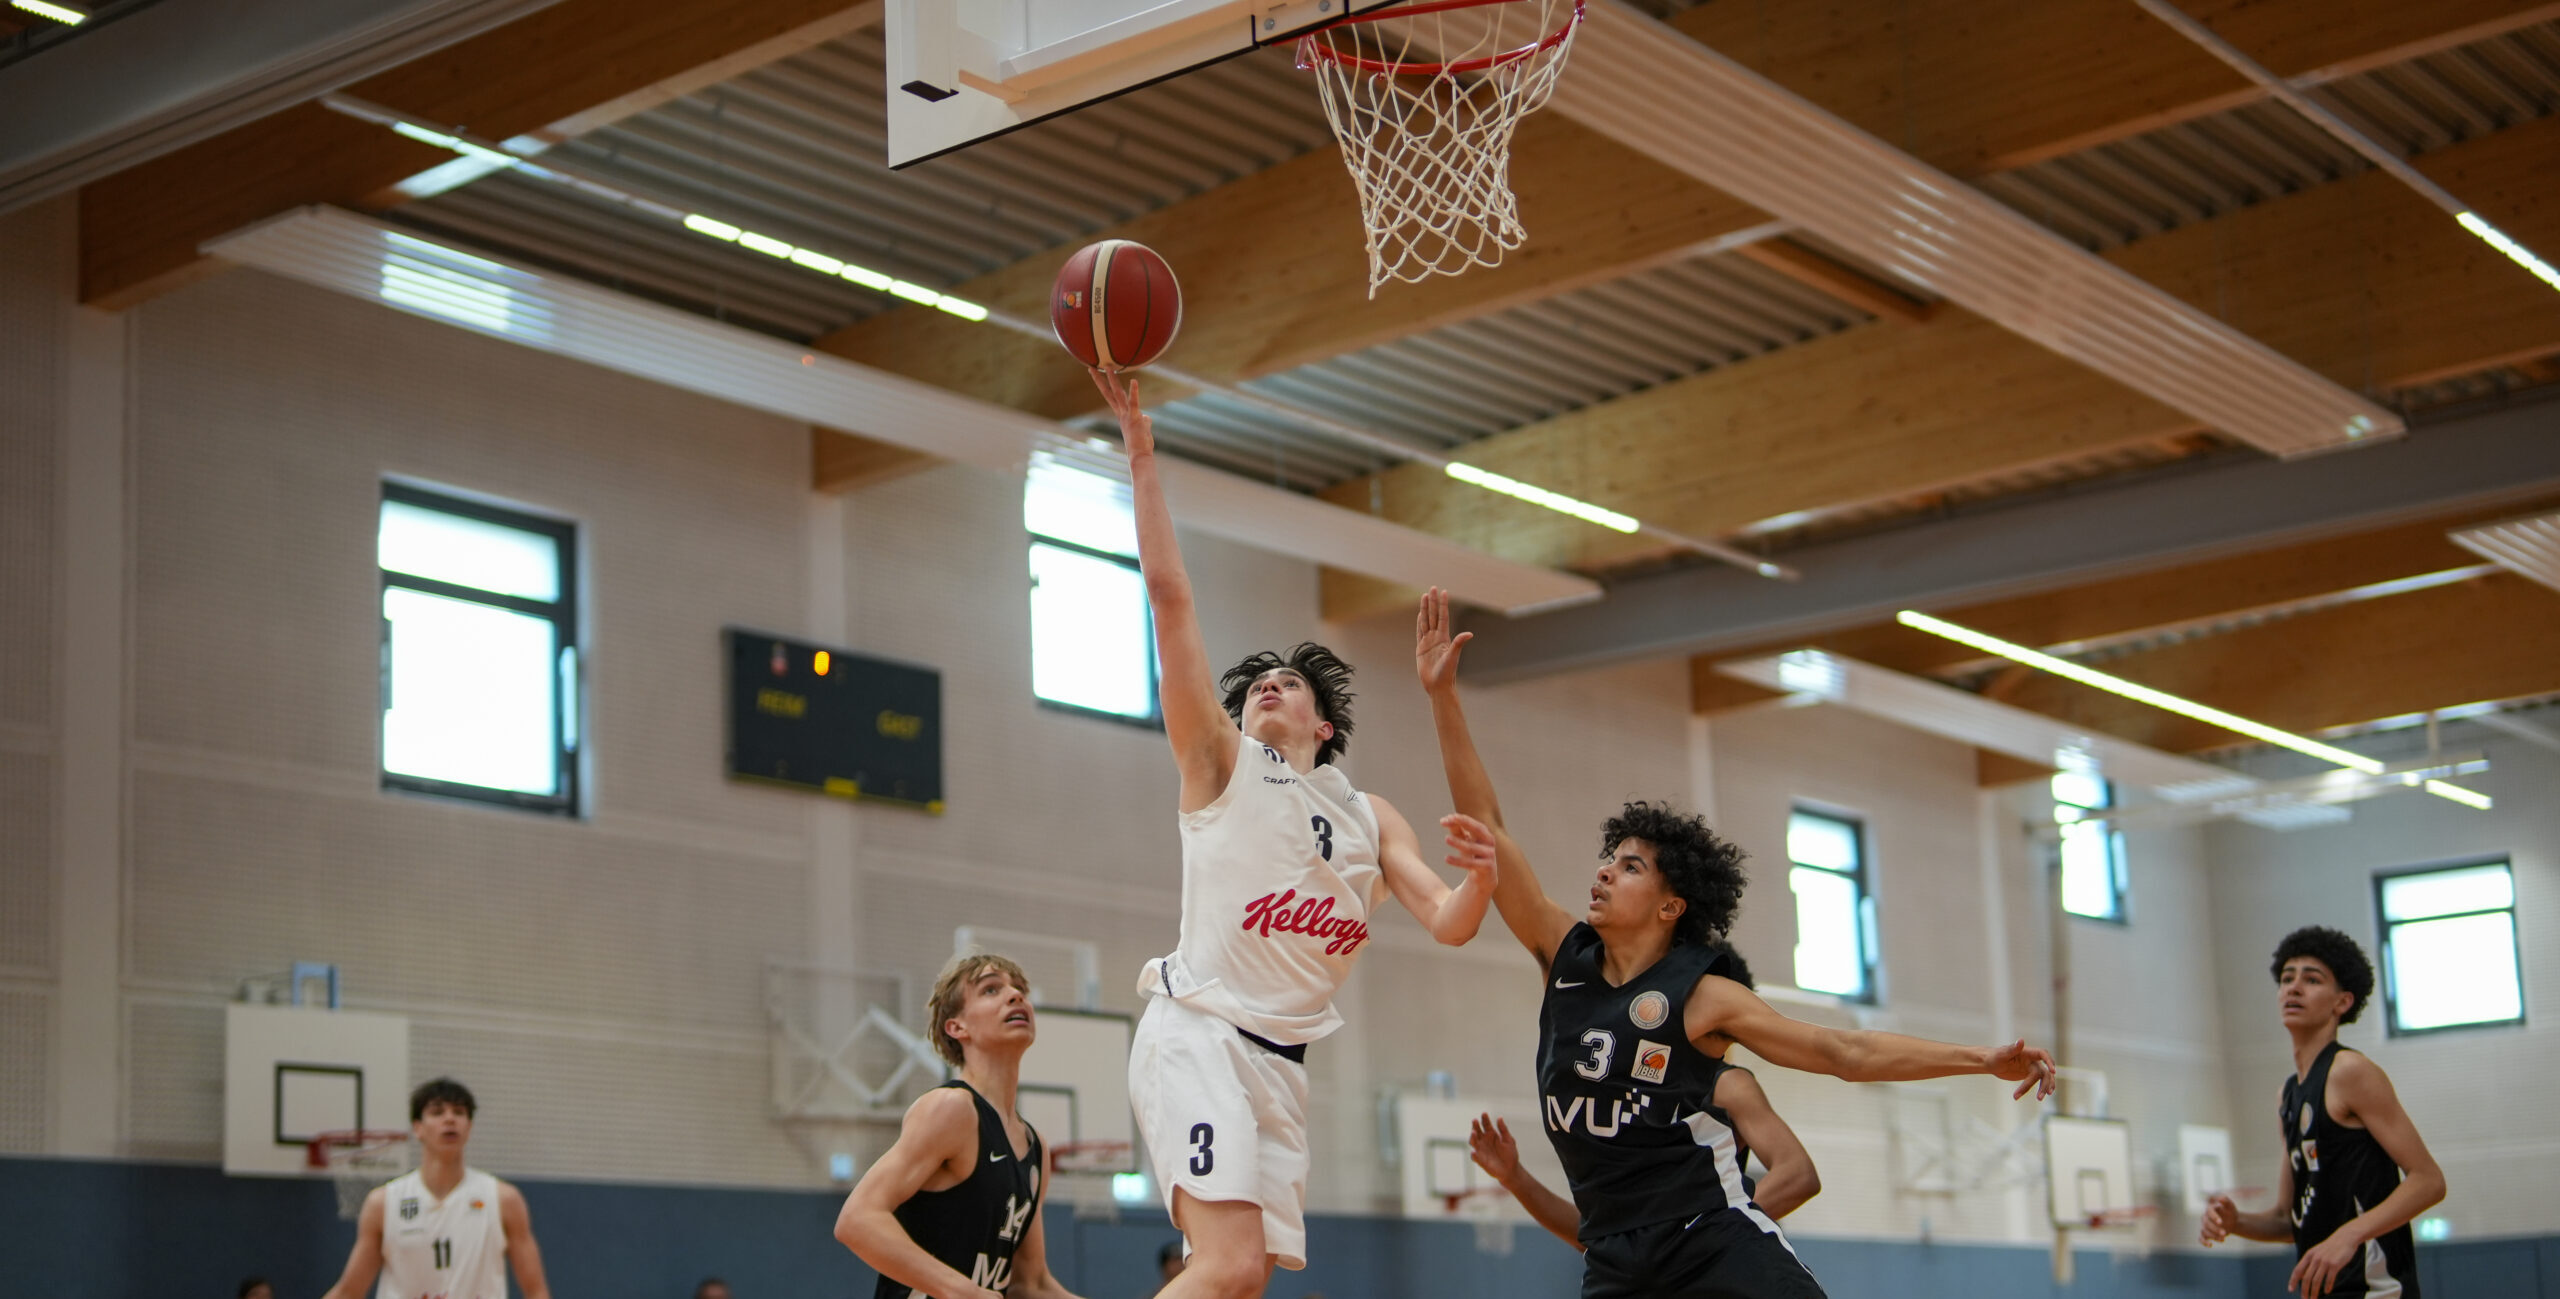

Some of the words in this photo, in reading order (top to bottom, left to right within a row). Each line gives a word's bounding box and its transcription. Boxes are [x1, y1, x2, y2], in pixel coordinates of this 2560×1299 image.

[1263, 776, 1297, 785] CRAFT
[1311, 815, 1333, 862] 3
[1574, 1028, 1616, 1082] 3
[1635, 1064, 1660, 1080] JBBL
[1189, 1122, 1214, 1177] 3
[999, 1193, 1032, 1242] 14
[432, 1237, 451, 1270] 11
